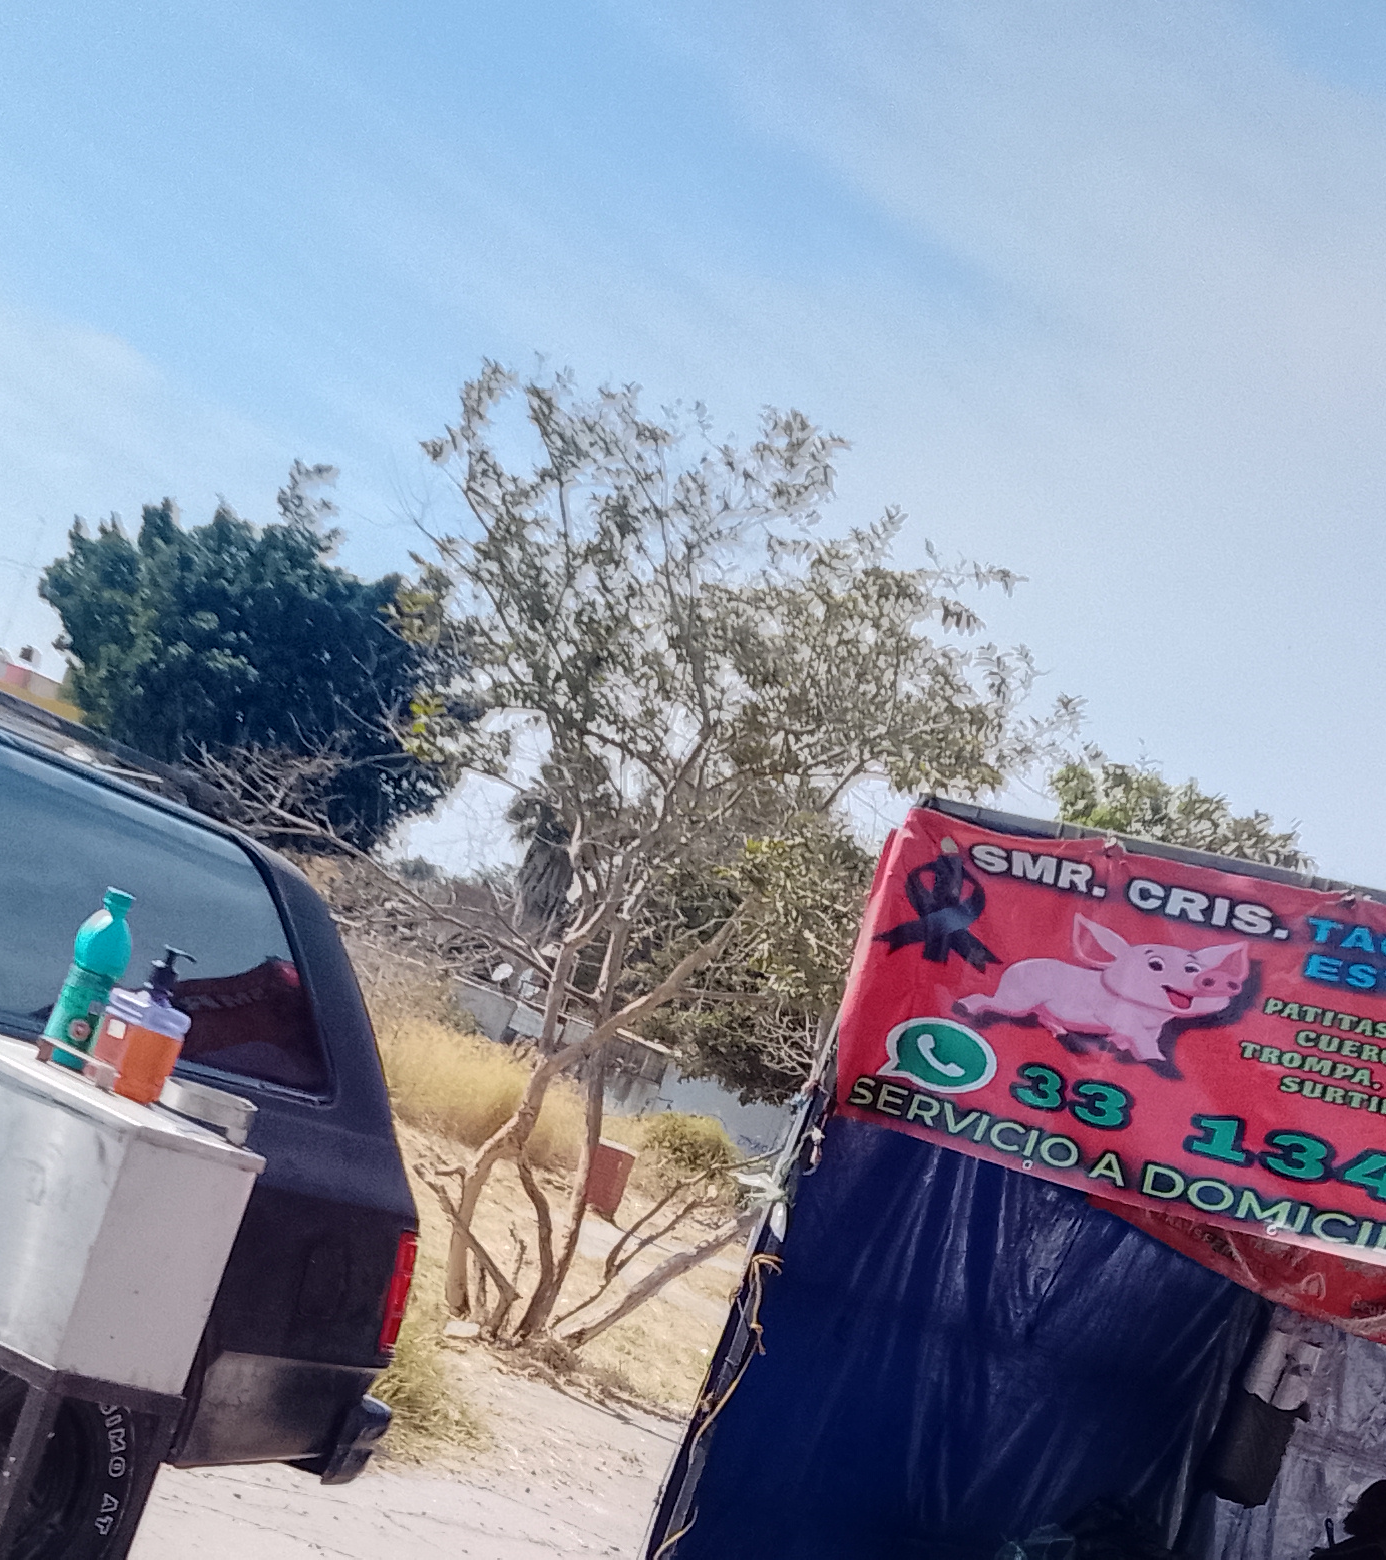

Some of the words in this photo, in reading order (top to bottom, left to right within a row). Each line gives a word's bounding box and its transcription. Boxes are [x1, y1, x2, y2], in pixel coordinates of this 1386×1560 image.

[970, 843, 1107, 900] SMR.
[1126, 877, 1292, 942] CRIS.
[848, 1076, 1081, 1173] SERVICIO
[1088, 1151, 1128, 1188] A
[1013, 1063, 1131, 1130] 33
